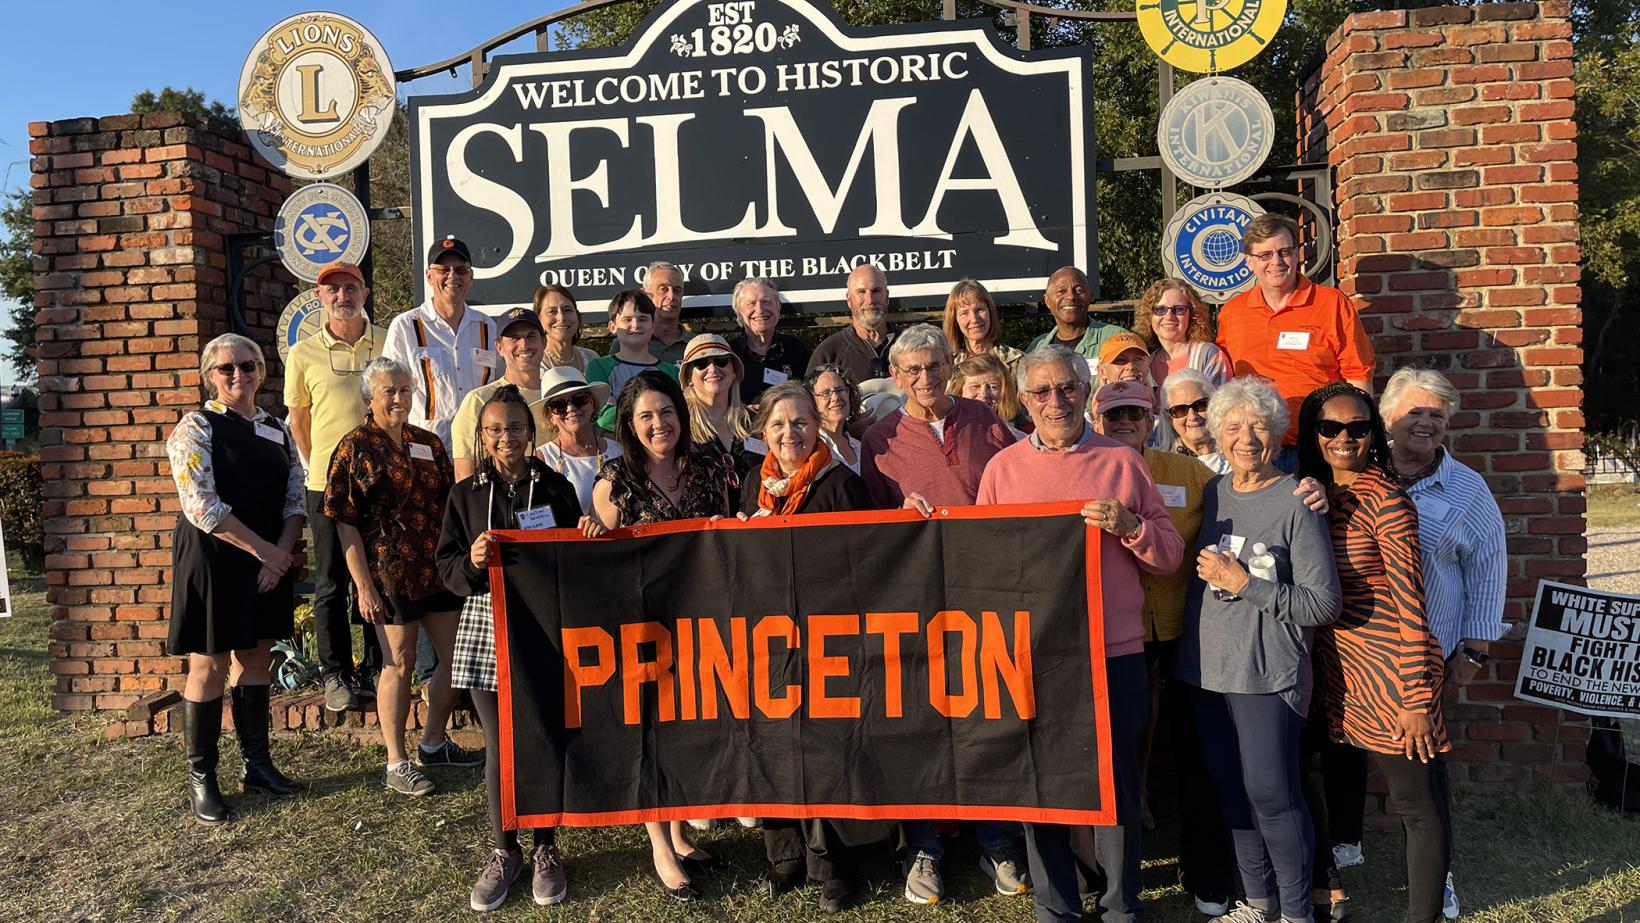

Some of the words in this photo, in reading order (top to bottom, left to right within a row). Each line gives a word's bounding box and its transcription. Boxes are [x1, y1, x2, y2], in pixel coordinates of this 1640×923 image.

[708, 1, 755, 26] EST
[1164, 1, 1259, 47] INTERNATIONAL
[276, 23, 356, 54] LIONS
[691, 22, 778, 57] 1820
[296, 64, 340, 124] L
[512, 73, 705, 110] WELCOME
[711, 66, 767, 97] TO
[776, 51, 969, 92] HISTORIC
[274, 125, 364, 157] INTERNATIONAL
[1170, 120, 1261, 176] INTERNATIONAL
[446, 89, 1058, 280] SELMA
[1185, 208, 1250, 233] CIVITAN
[540, 266, 626, 288] QUEEN
[633, 262, 694, 285] CY
[700, 262, 734, 281] OF
[740, 258, 796, 279] THE
[802, 249, 957, 277] BLACKBELT
[1180, 254, 1253, 287] INTERNATIO
[1551, 590, 1607, 613] WHITE
[1560, 607, 1640, 642] MUST
[1530, 645, 1606, 680] BLACK
[1570, 636, 1629, 660] FIGHT
[561, 610, 1036, 729] PRINCETON
[1530, 666, 1549, 680] TO
[1552, 672, 1582, 687] END
[1586, 679, 1609, 693] THE
[1611, 682, 1640, 696] NEW
[1627, 697, 1635, 708] &
